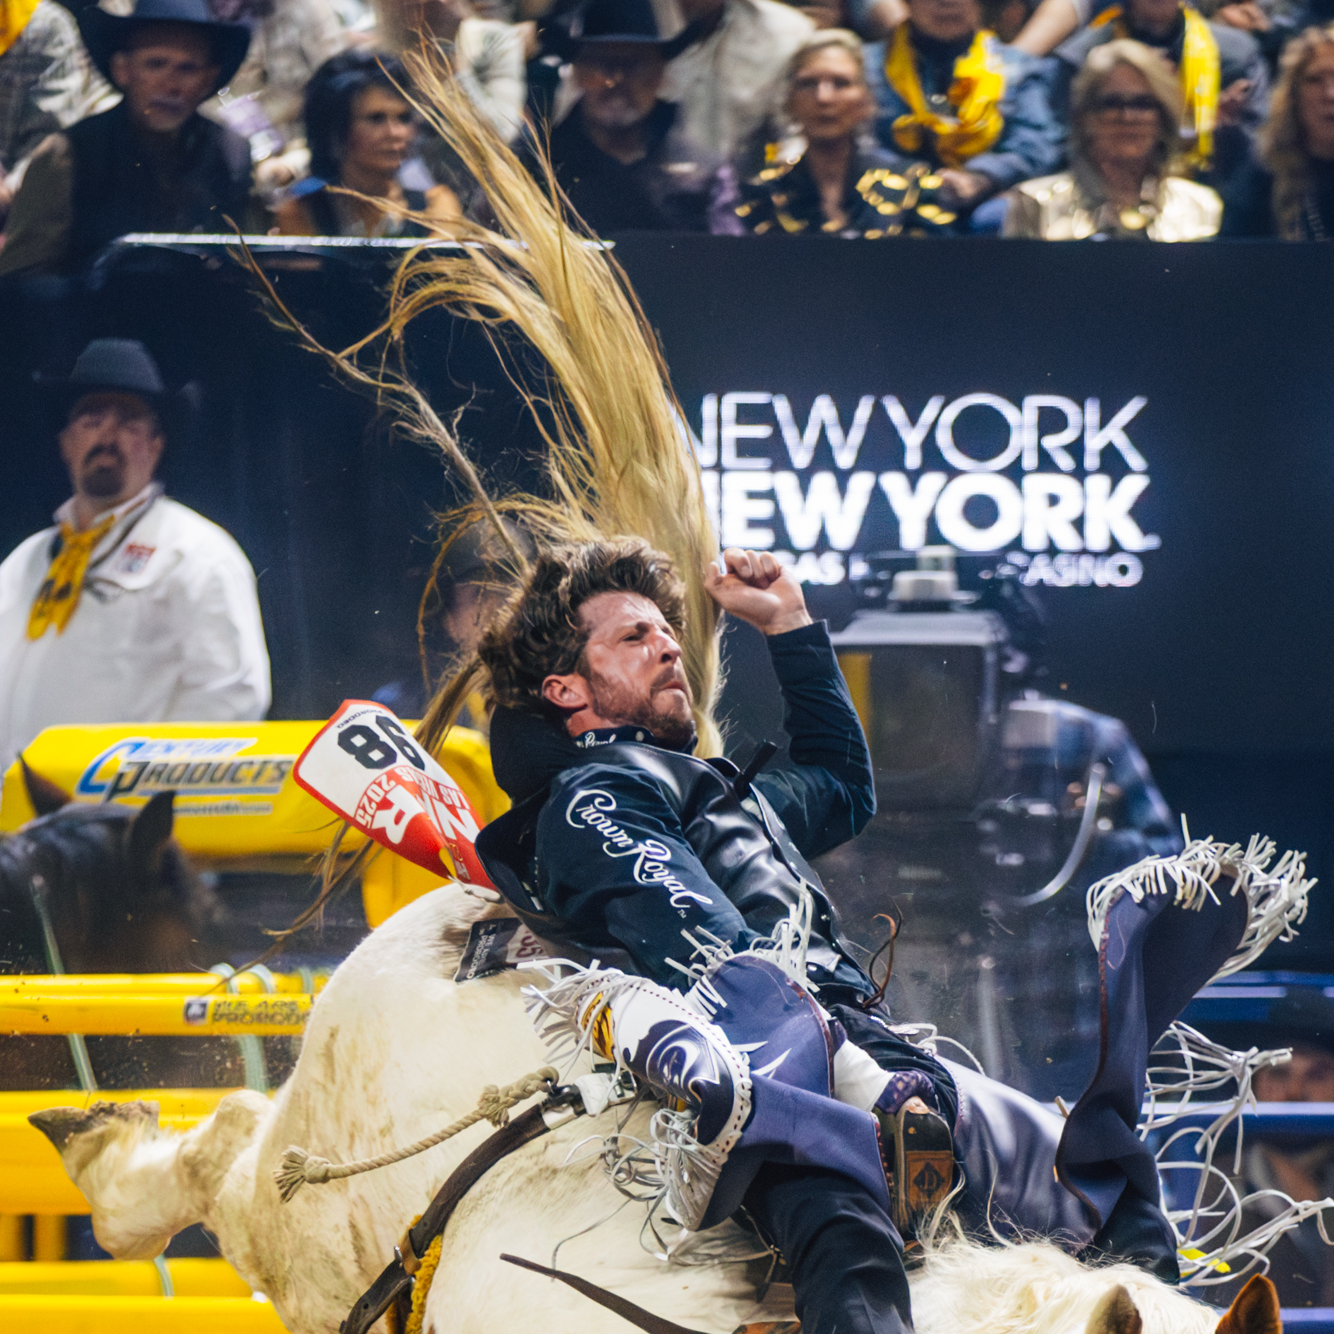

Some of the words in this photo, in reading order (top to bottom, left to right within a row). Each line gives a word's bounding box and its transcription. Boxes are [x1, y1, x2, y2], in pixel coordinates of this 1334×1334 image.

[881, 392, 1149, 472] YORK
[878, 470, 1152, 552] YORK
[105, 758, 296, 803] PRODUCTS
[566, 789, 634, 858] Crown
[633, 839, 713, 908] Royal
